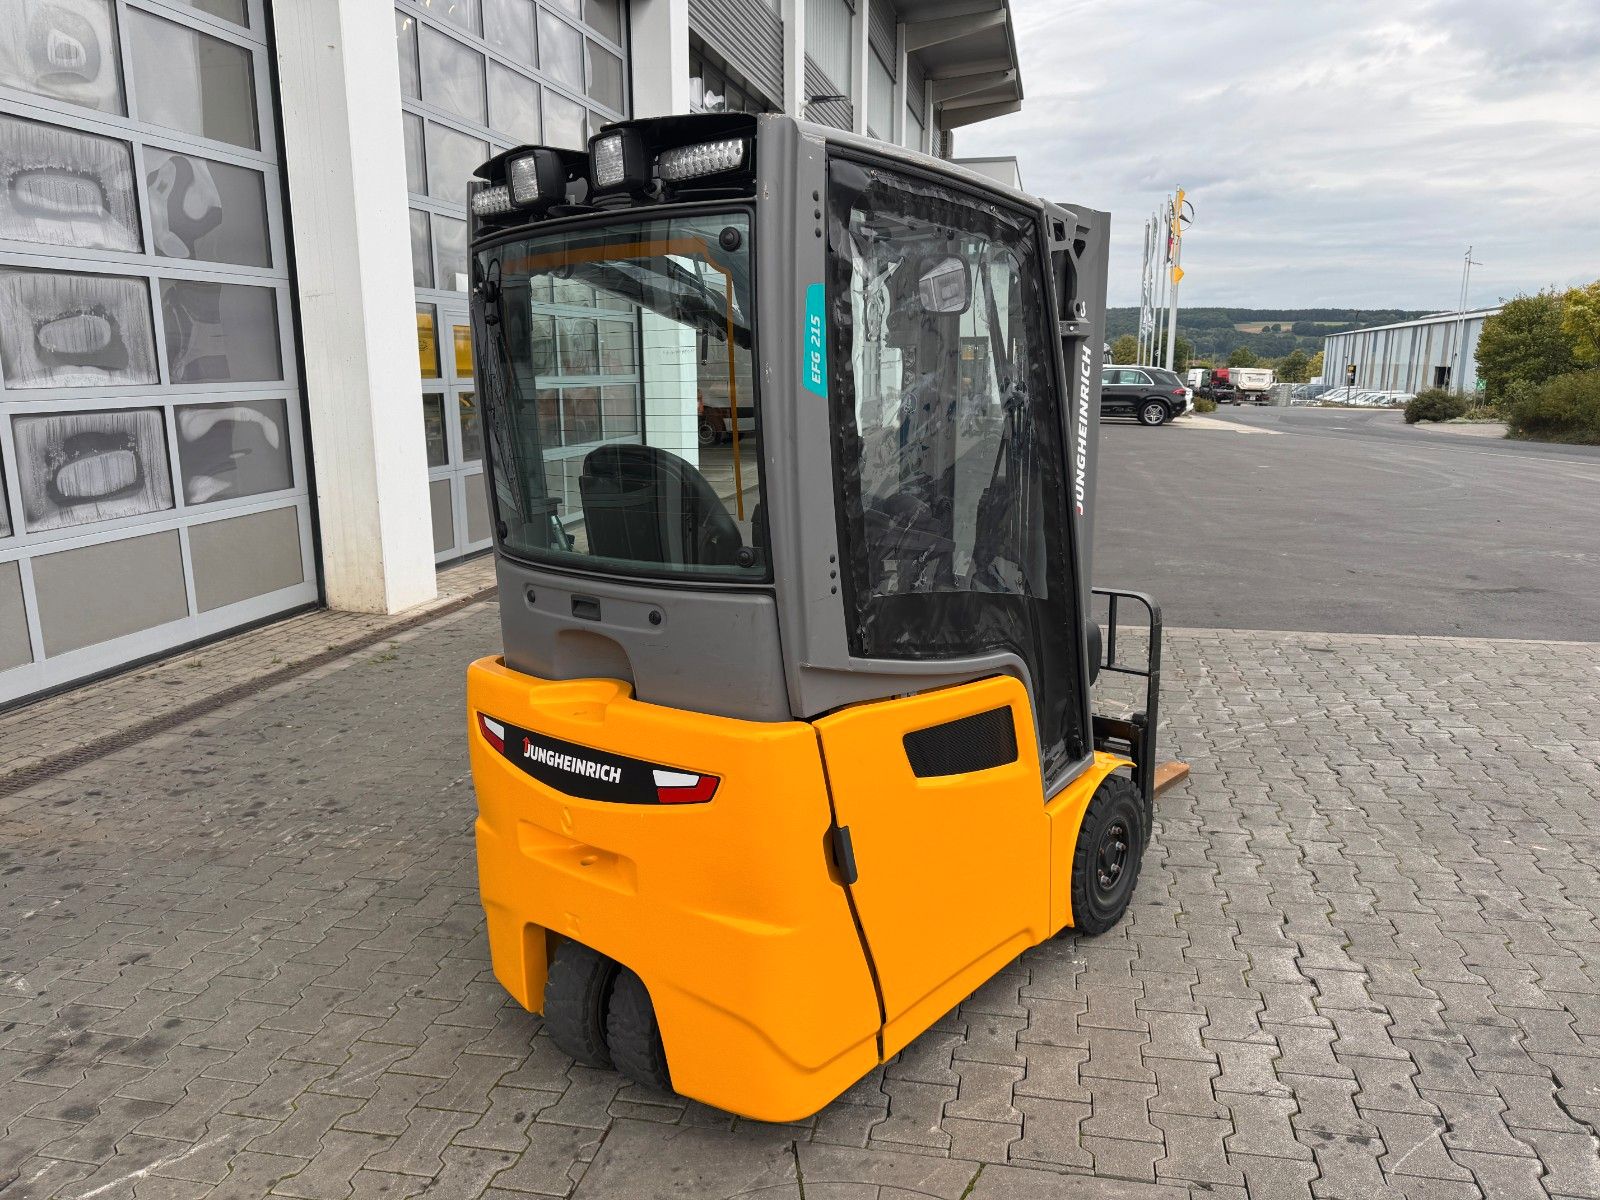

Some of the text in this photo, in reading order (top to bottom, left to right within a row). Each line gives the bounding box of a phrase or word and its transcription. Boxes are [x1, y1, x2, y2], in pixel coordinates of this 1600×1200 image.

[811, 314, 821, 385] EFG 215
[1075, 345, 1092, 516] JUNGHEINRICH
[523, 742, 622, 784] JUNGHEINRICH
